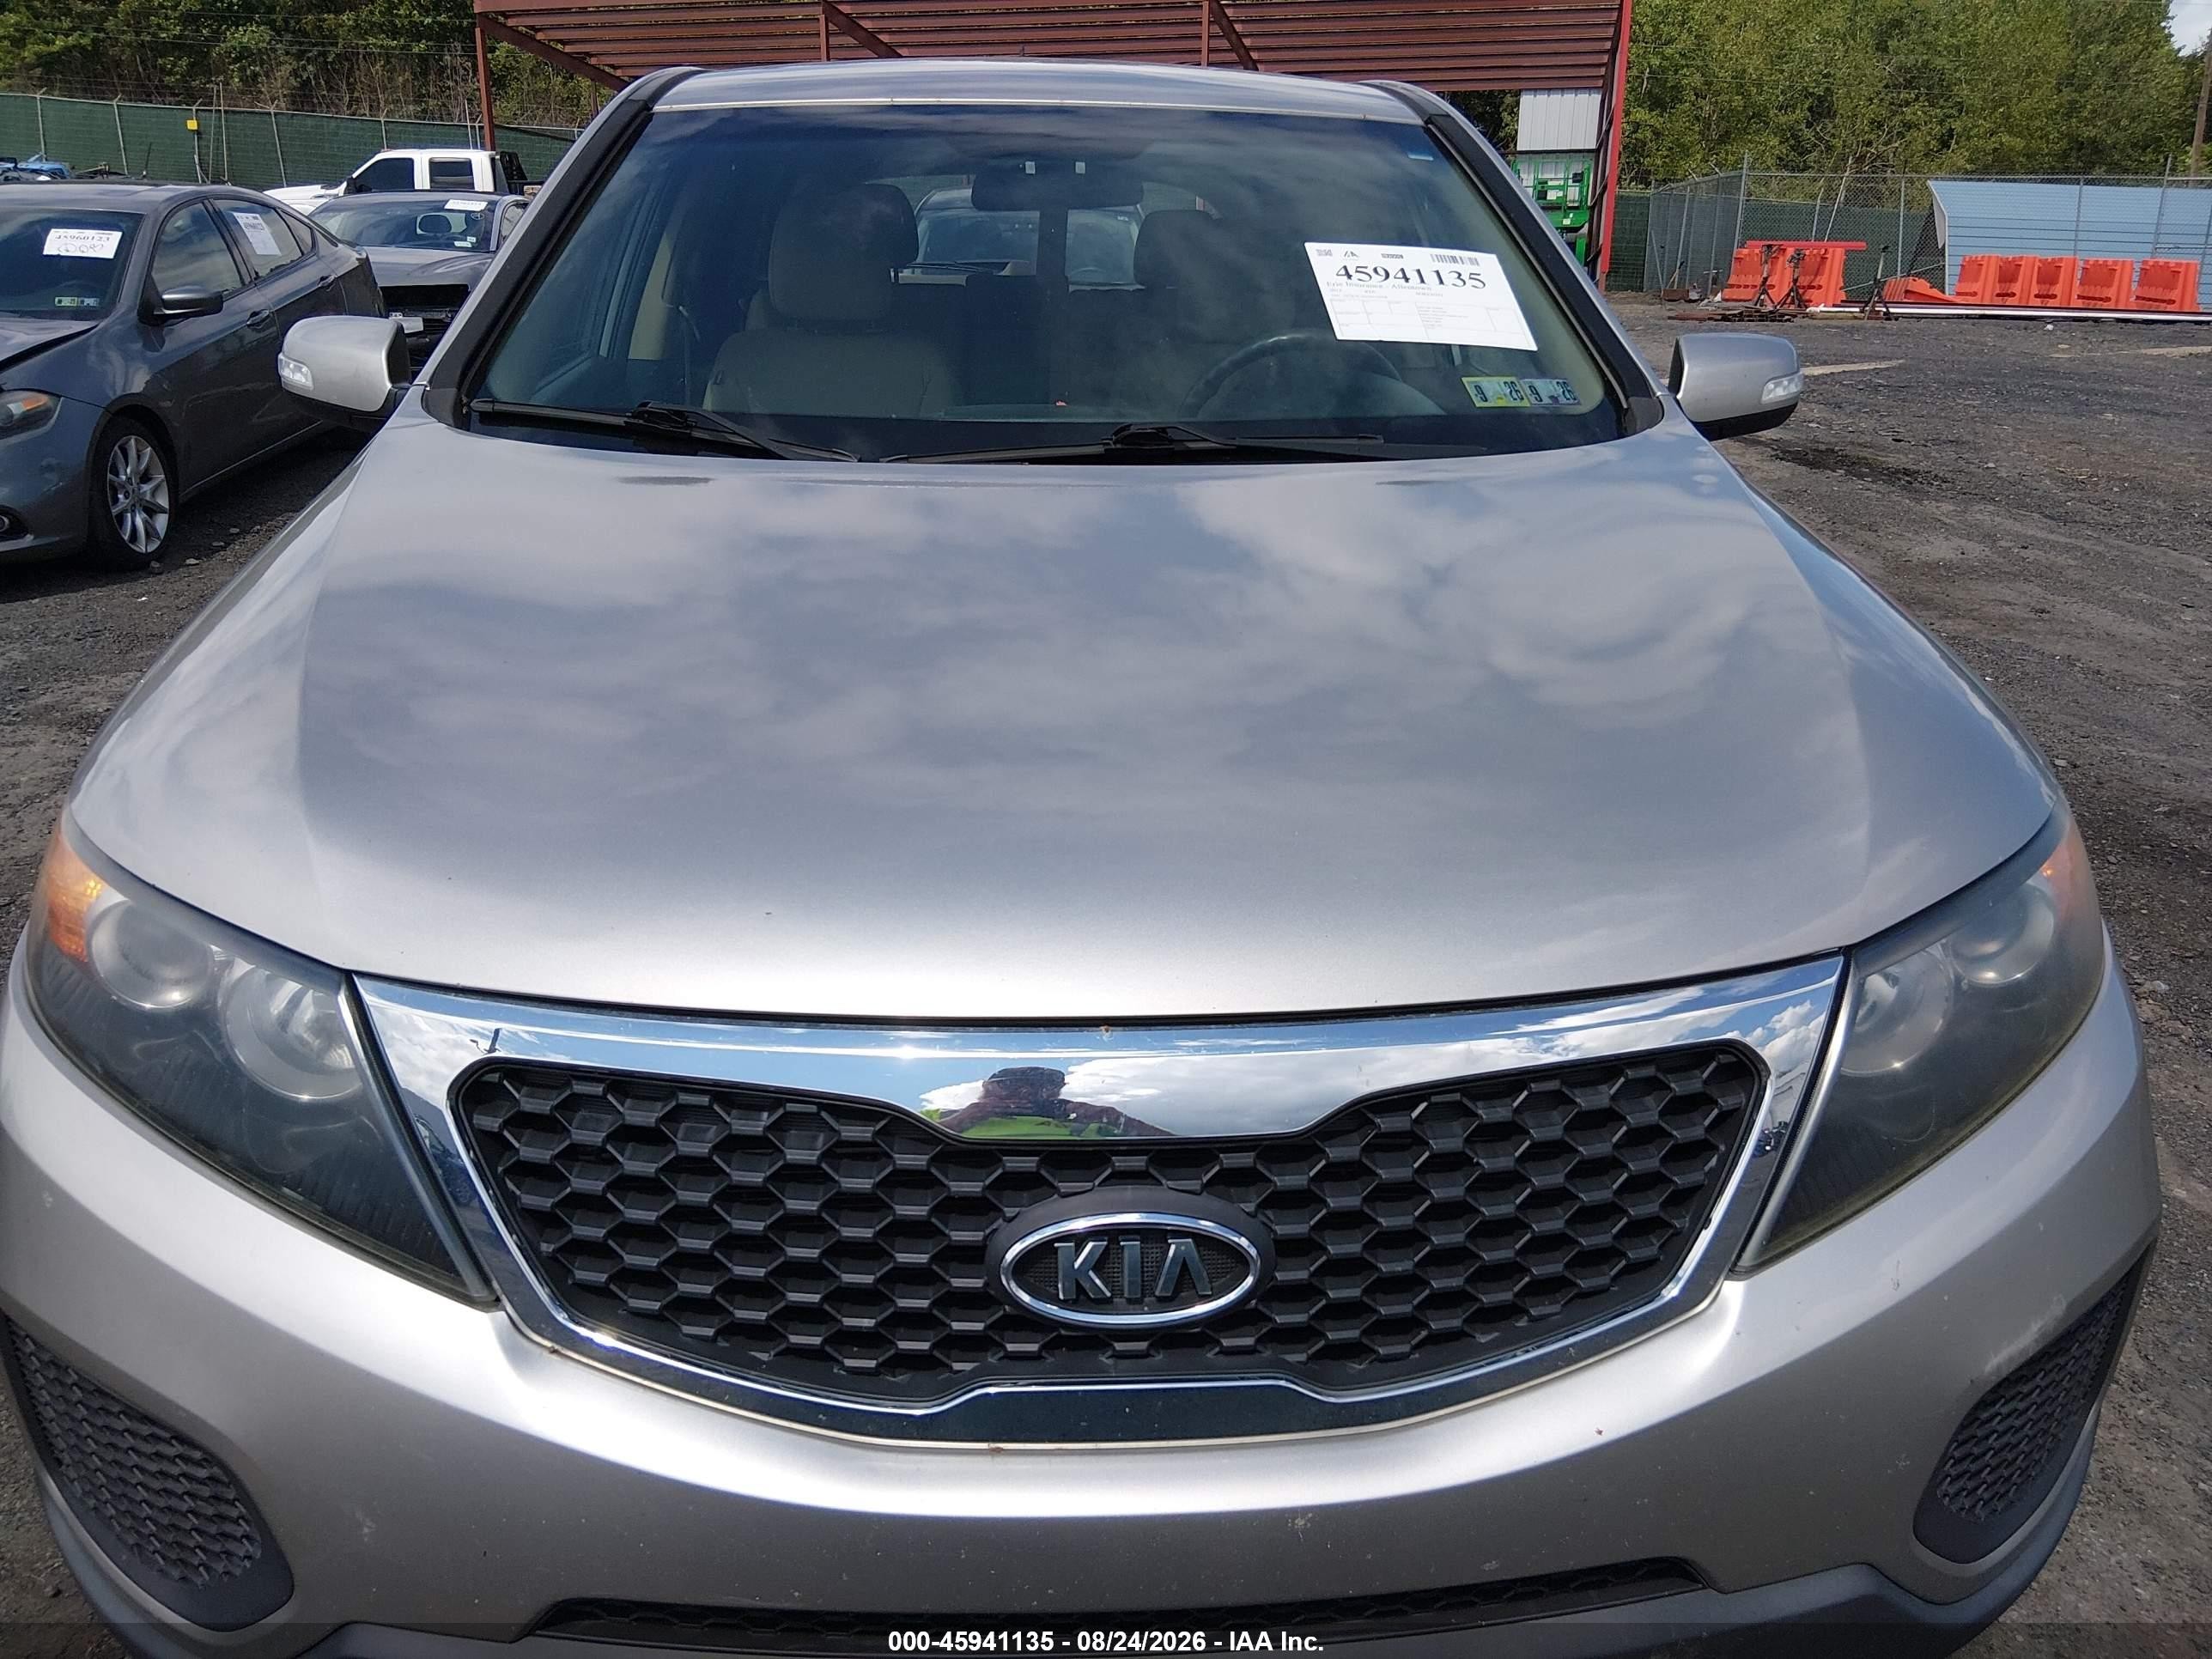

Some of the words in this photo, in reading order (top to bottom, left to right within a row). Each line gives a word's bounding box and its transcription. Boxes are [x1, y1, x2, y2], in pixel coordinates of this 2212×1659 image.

[1335, 264, 1486, 289] 45941135
[1474, 384, 1488, 403] 9
[1503, 380, 1524, 401] 26
[1528, 385, 1543, 403] 9
[1556, 380, 1577, 401] 26
[1054, 1235, 1212, 1300] KIA
